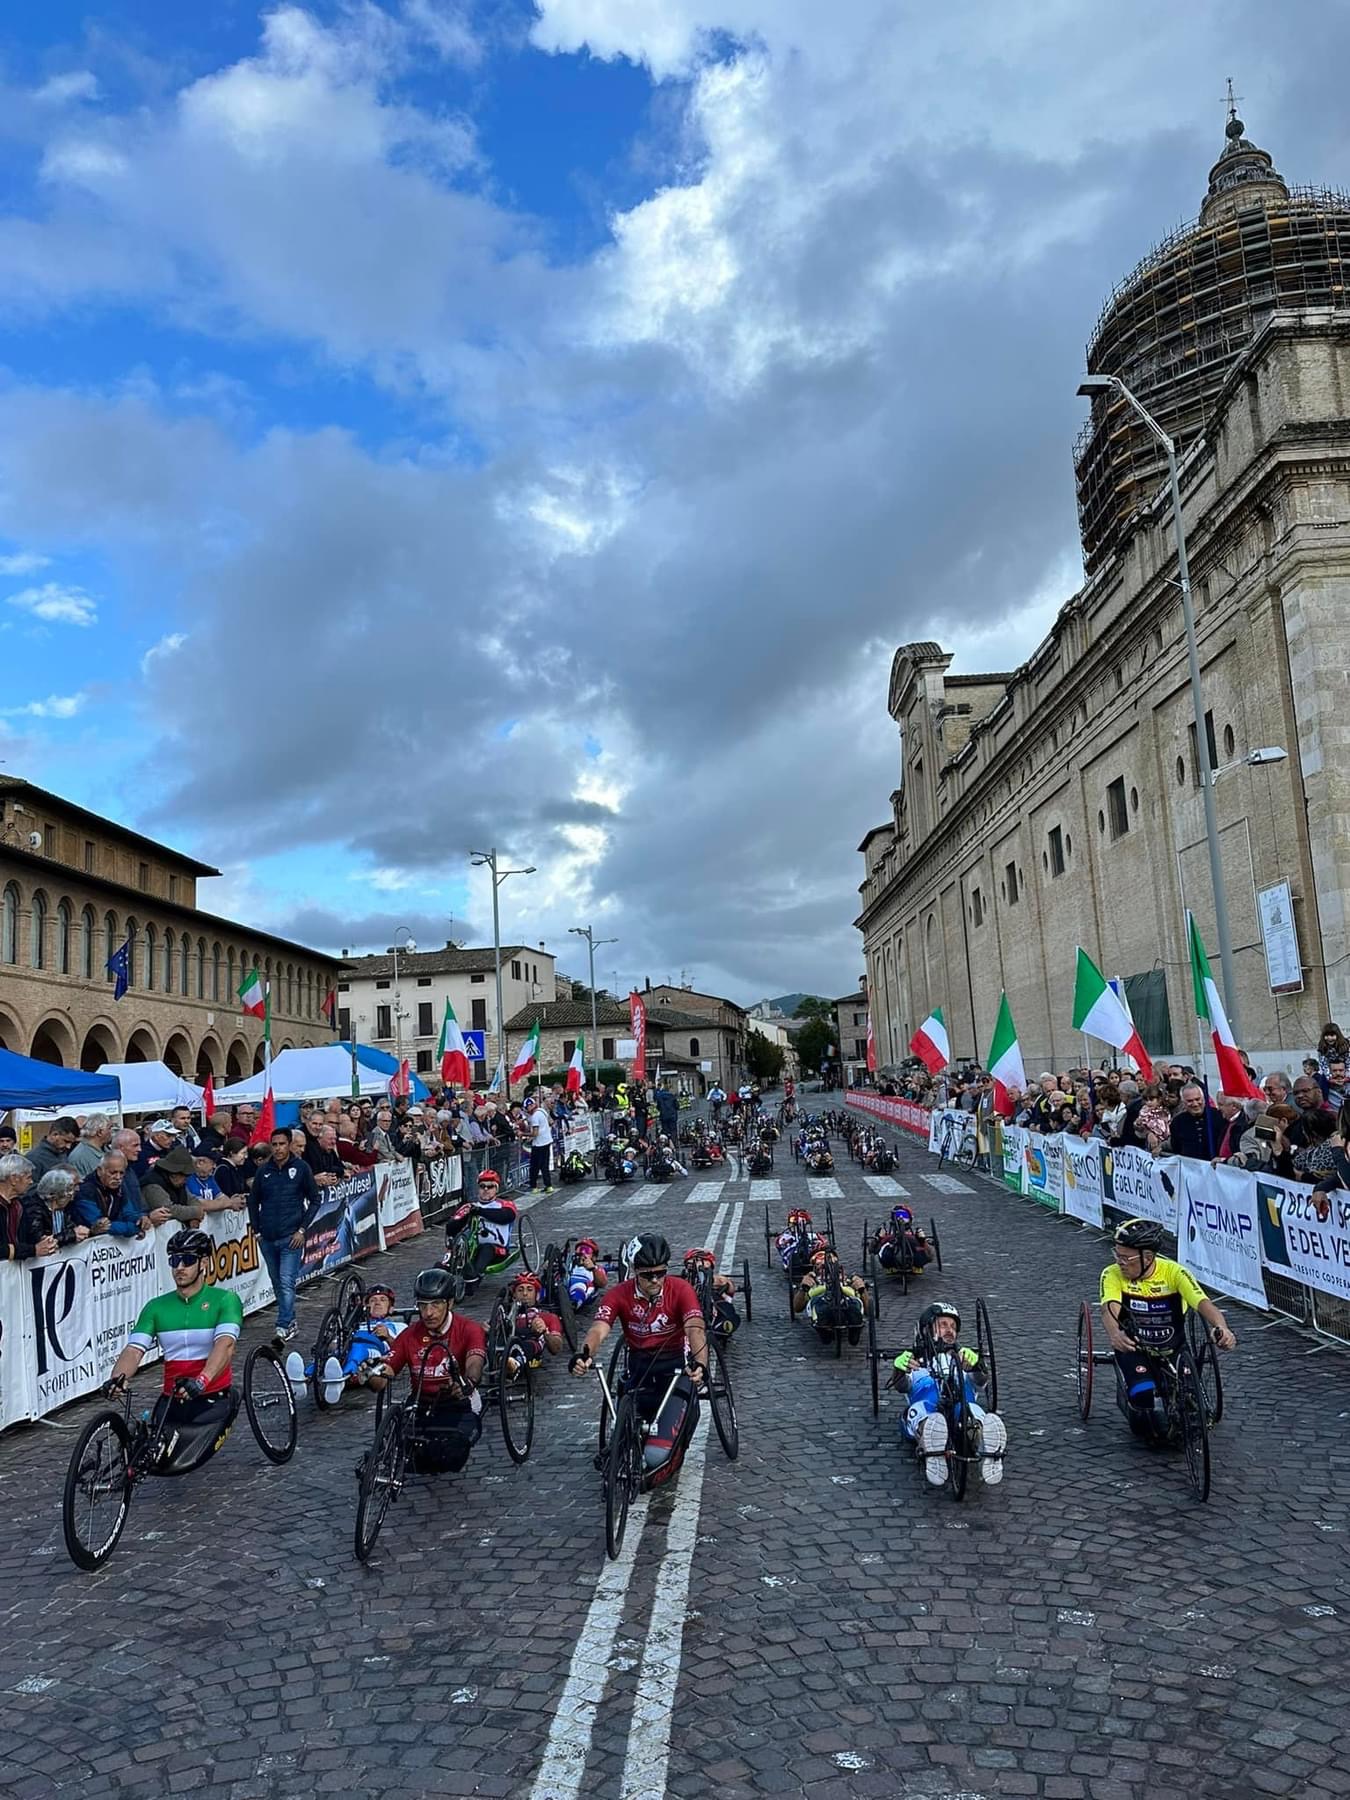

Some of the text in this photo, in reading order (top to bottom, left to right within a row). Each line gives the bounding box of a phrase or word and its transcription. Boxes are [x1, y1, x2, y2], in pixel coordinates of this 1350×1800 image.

[1287, 1191, 1312, 1221] BCC
[1287, 1225, 1298, 1252] E
[1298, 1228, 1330, 1261] DEL
[91, 1251, 156, 1288] PC INFORTUNI
